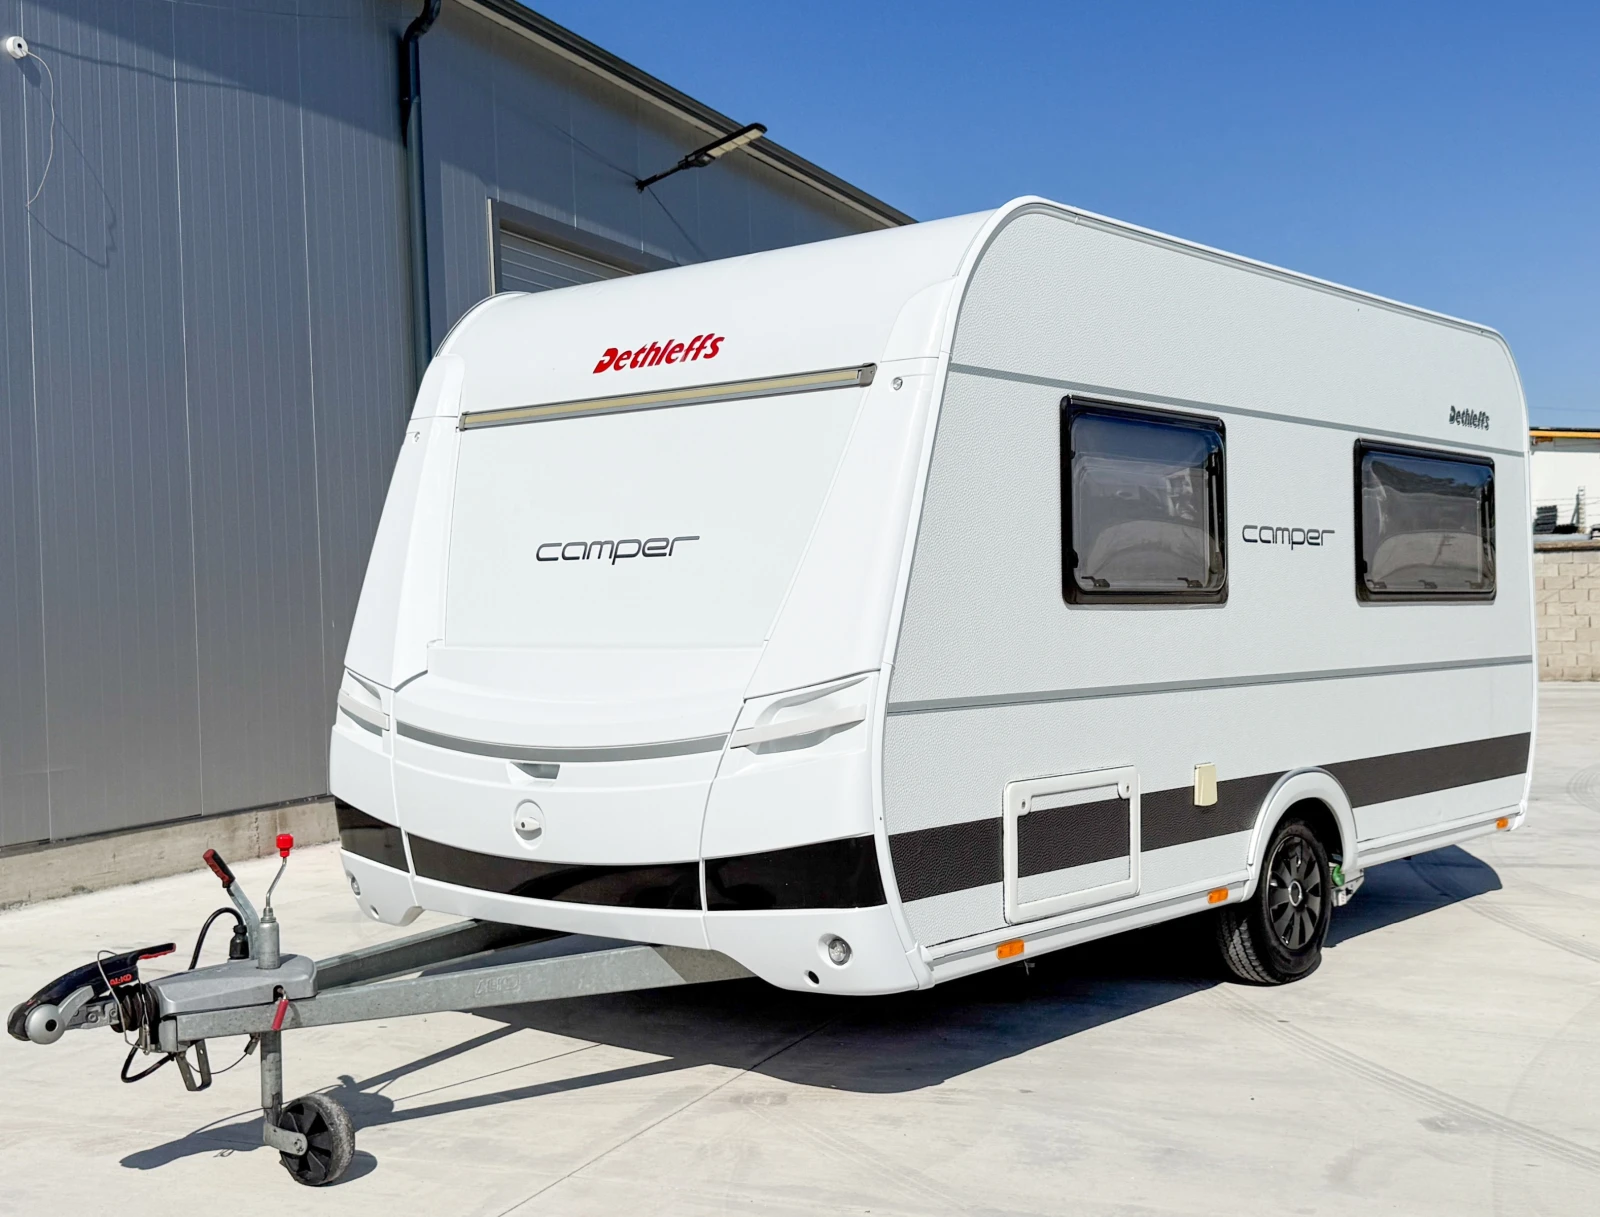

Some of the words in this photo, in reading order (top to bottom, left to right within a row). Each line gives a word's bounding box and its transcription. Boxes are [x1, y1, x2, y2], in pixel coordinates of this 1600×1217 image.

[592, 333, 725, 374] Dethleffs
[1449, 405, 1490, 431] Dethleffs
[535, 535, 700, 565] camper
[1242, 524, 1336, 550] camper
